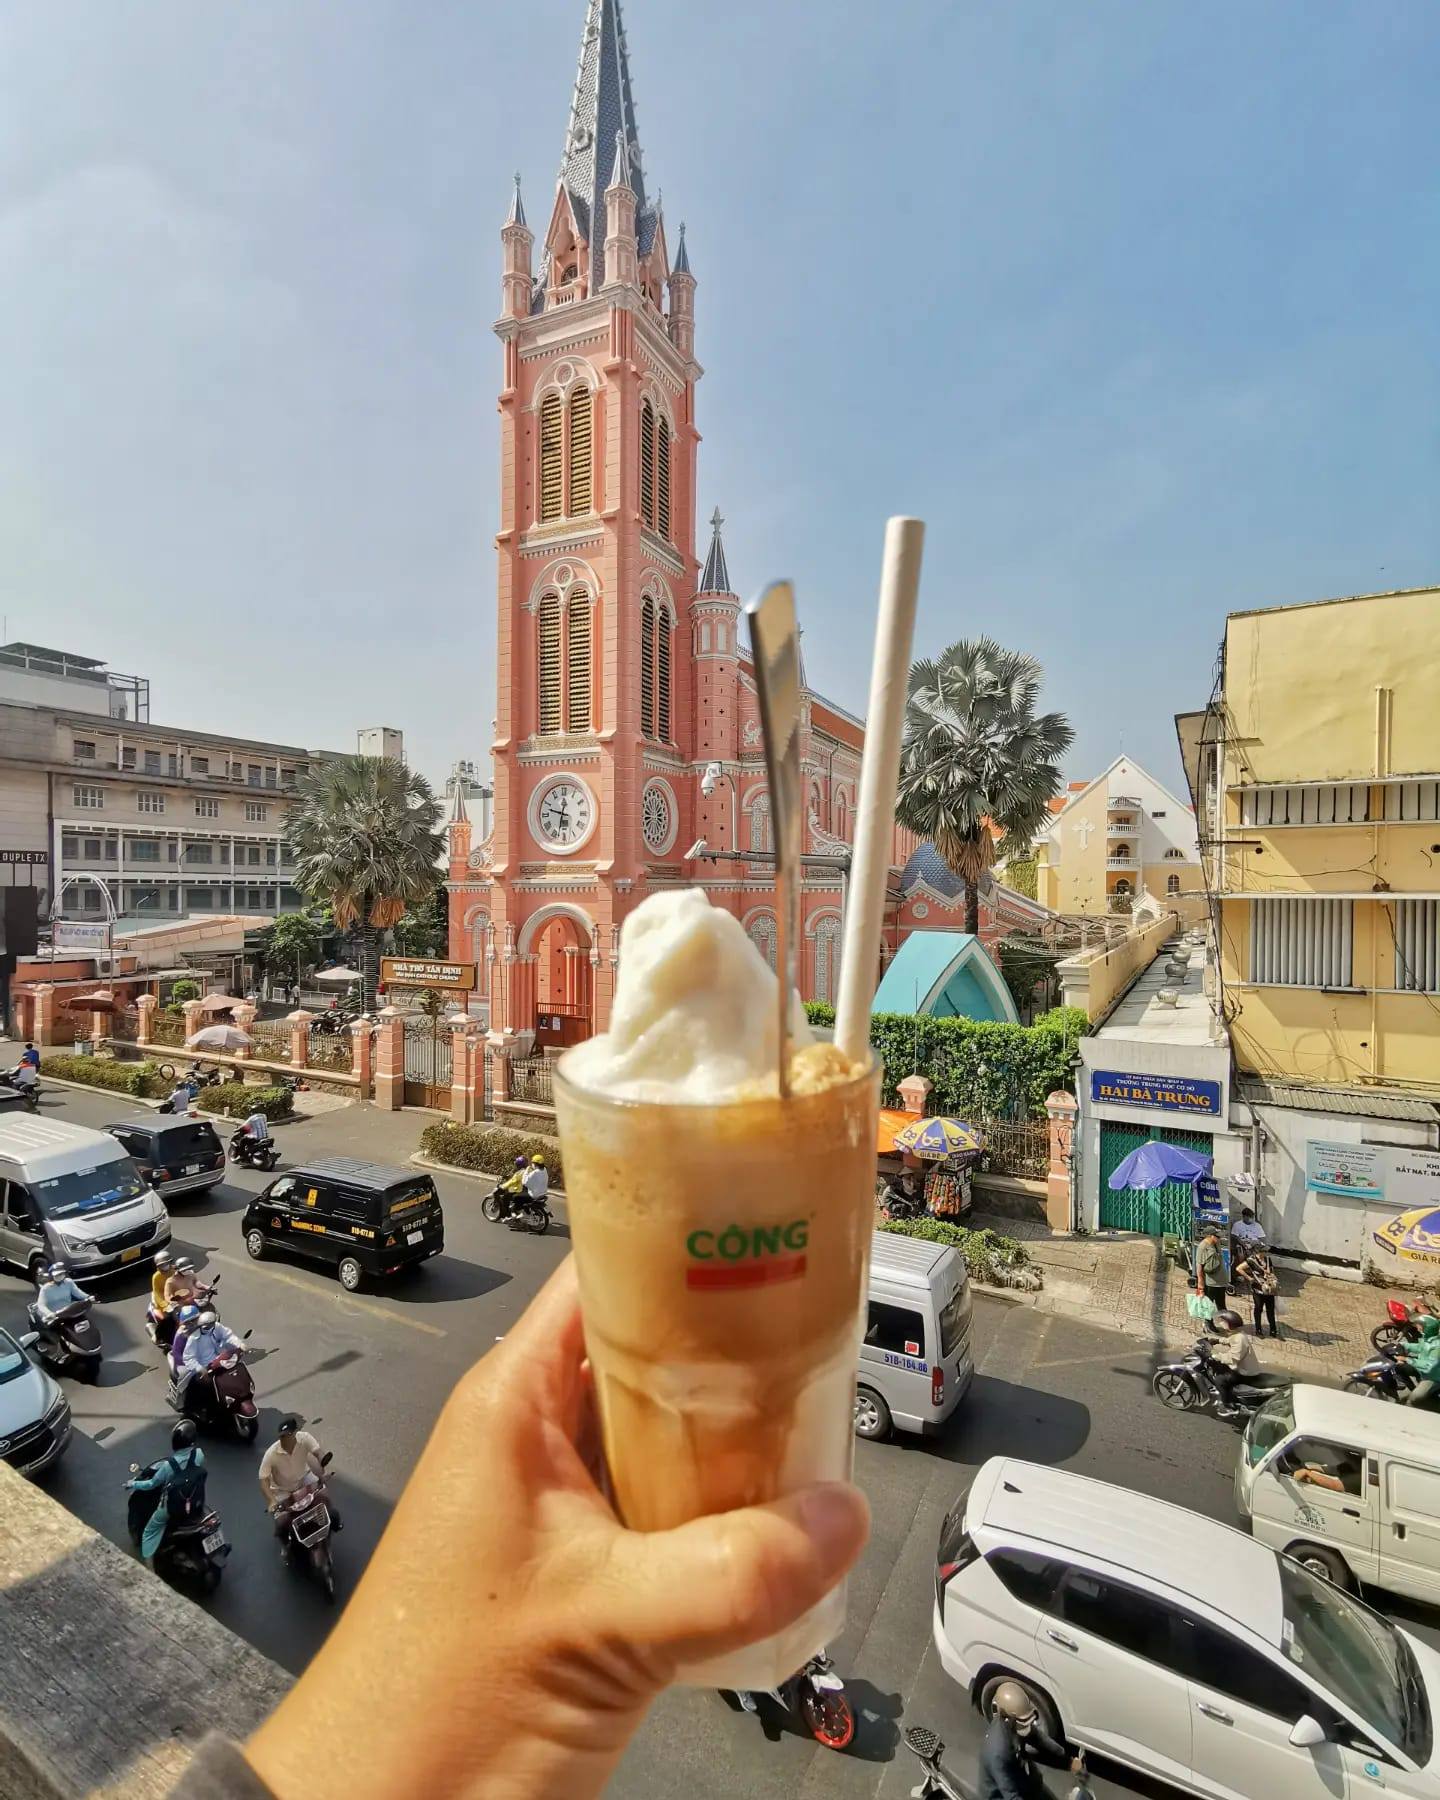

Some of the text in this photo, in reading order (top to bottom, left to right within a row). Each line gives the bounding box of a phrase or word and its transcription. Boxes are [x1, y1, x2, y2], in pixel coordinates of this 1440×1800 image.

[34, 853, 45, 862] TX
[1100, 1085, 1129, 1097] HAI
[1132, 1086, 1153, 1100] BÀ
[1411, 1252, 1430, 1262] GIÁ
